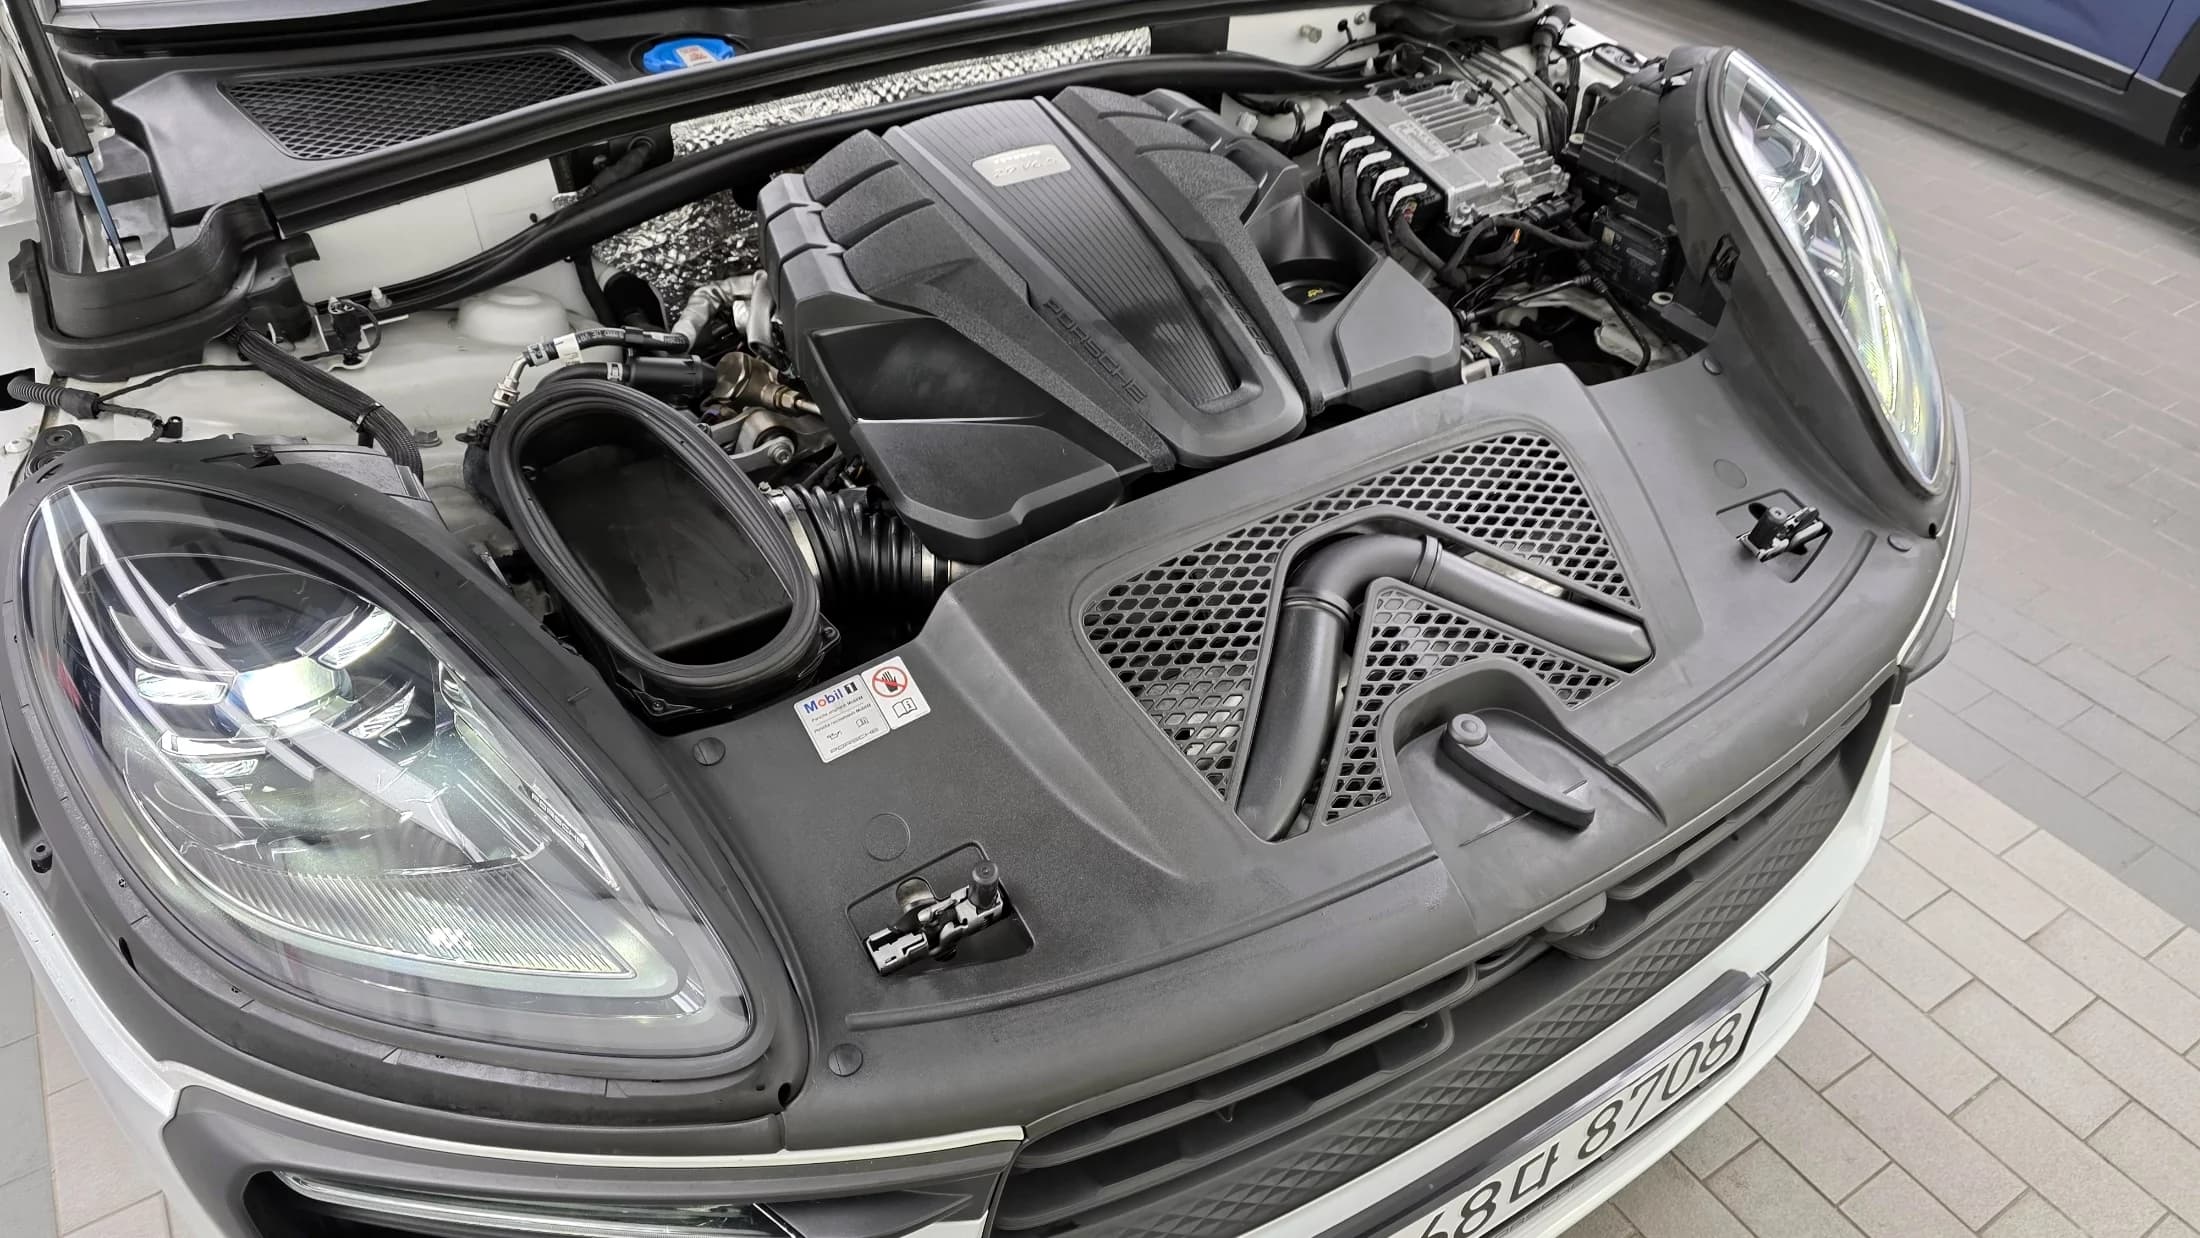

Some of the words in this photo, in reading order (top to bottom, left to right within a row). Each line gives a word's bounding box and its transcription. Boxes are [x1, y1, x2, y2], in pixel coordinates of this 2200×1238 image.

[1042, 298, 1148, 404] PORSCHE
[803, 688, 844, 714] Mobil
[844, 681, 858, 695] 1
[531, 791, 585, 849] PORSCHE
[1577, 1012, 1742, 1160] 8708
